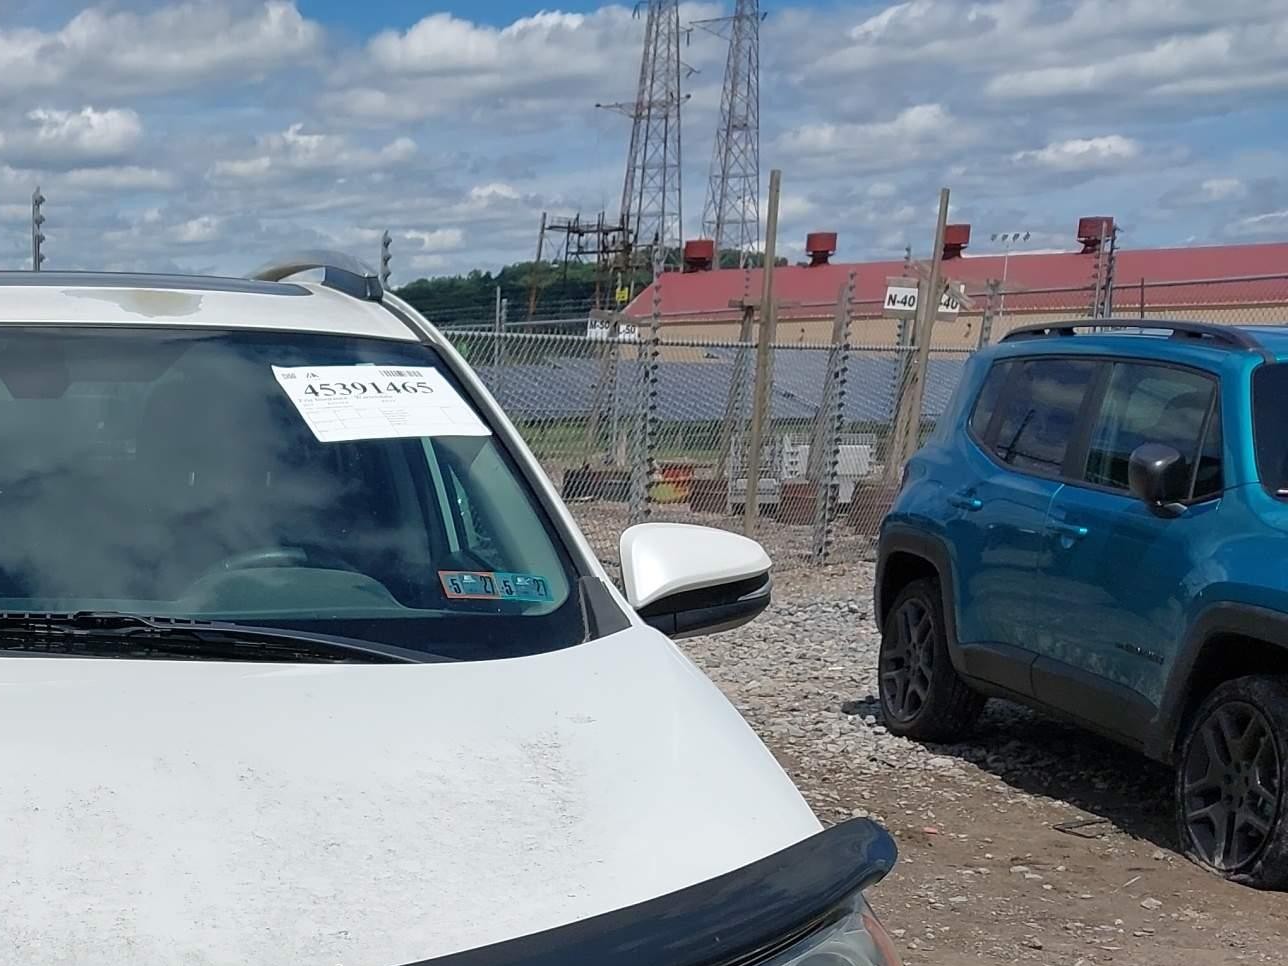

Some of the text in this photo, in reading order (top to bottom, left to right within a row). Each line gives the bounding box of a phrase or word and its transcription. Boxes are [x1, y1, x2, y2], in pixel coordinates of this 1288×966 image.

[887, 293, 916, 307] N-40
[304, 381, 434, 397] 45391465
[450, 578, 462, 594] 5
[503, 580, 514, 595] 5
